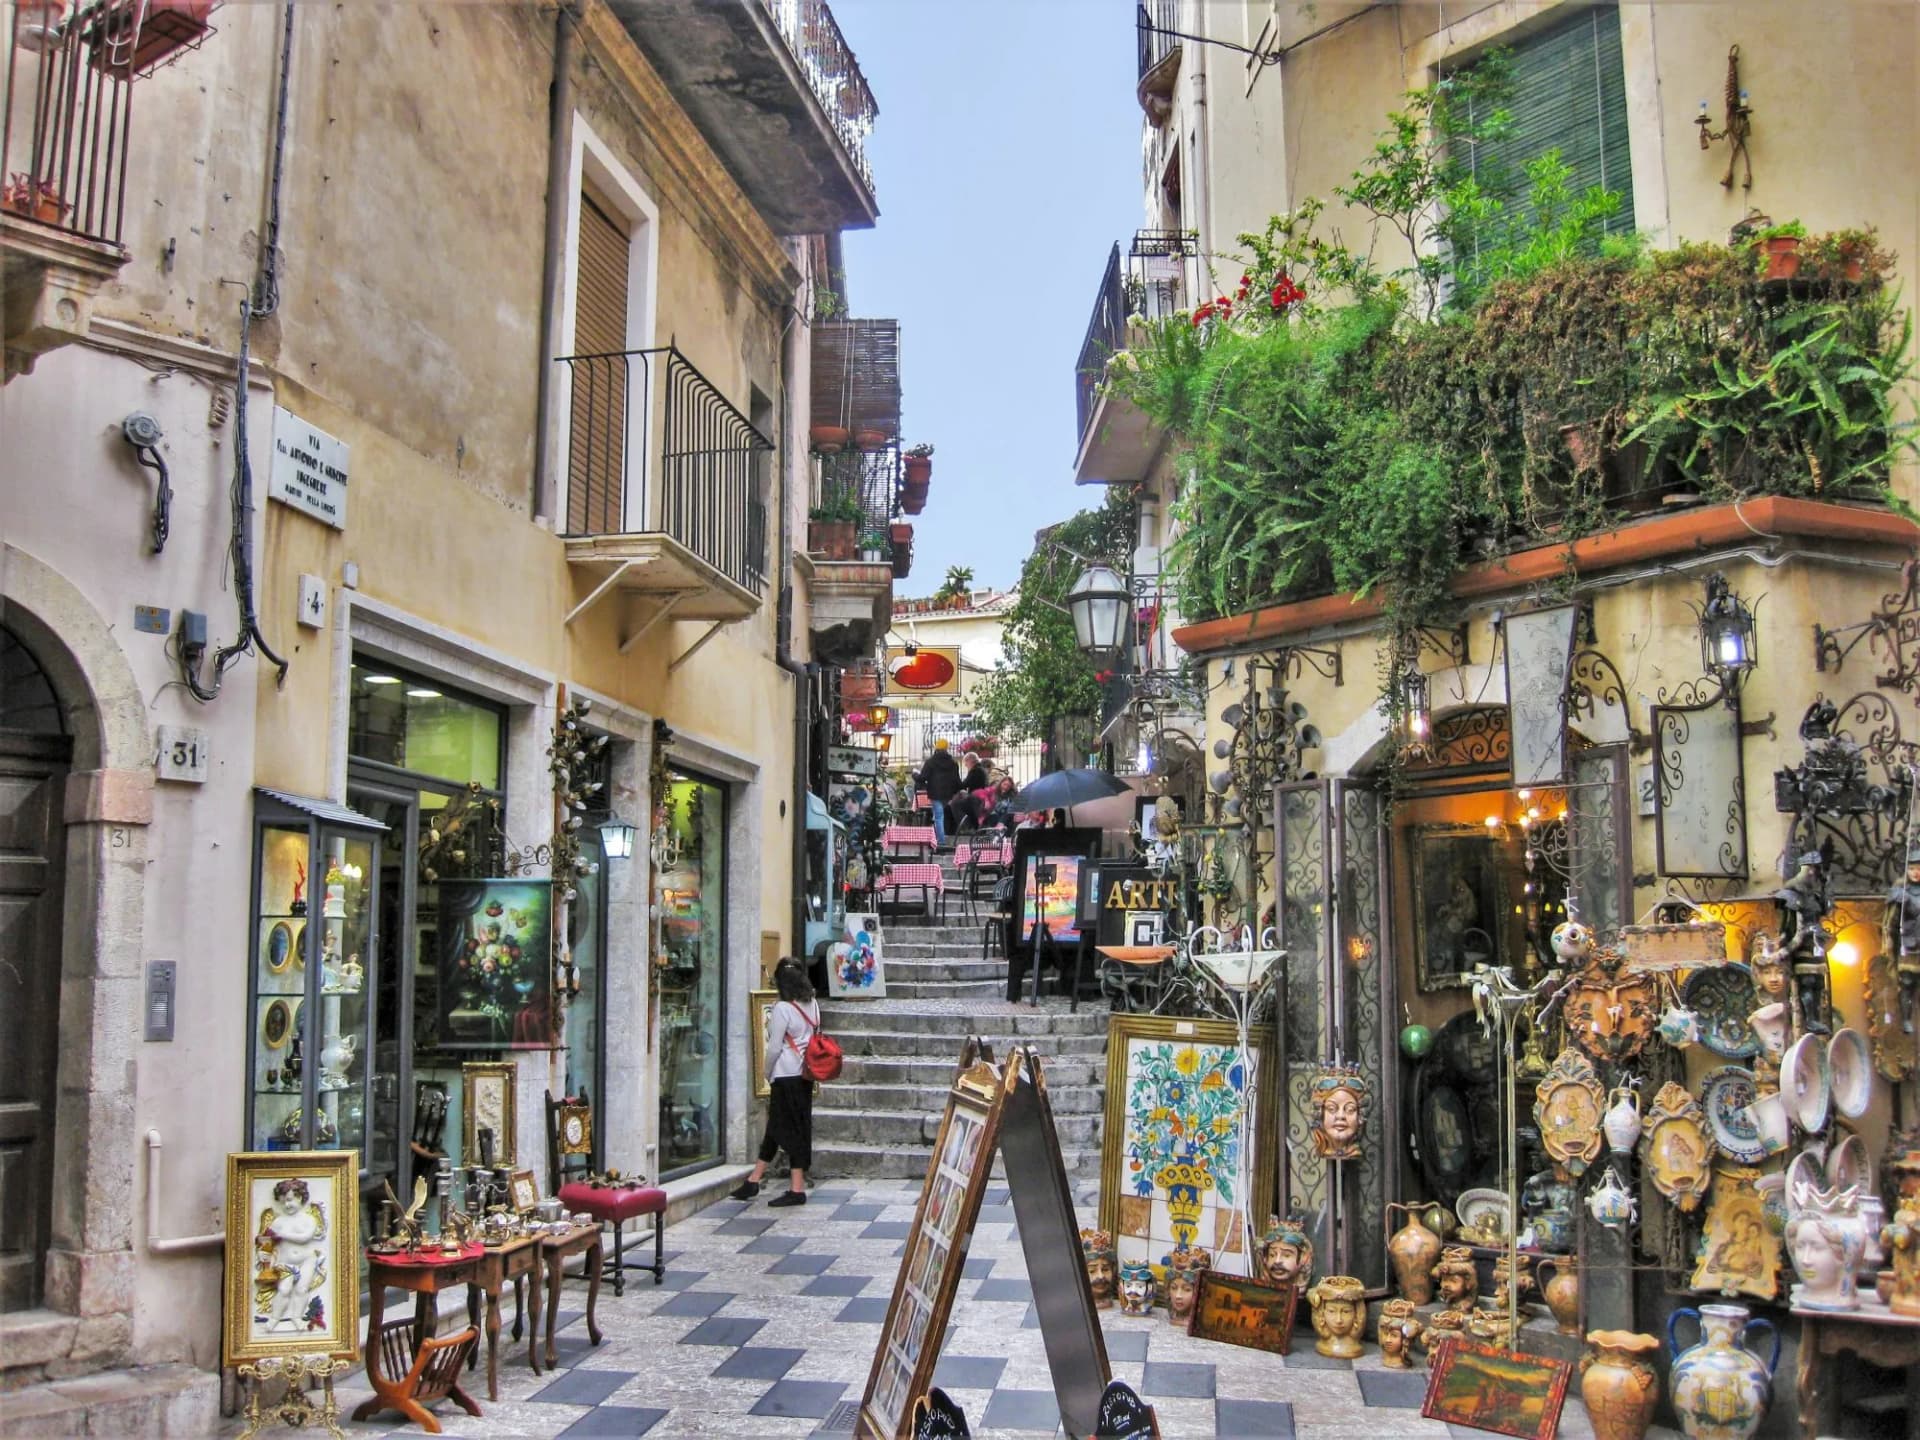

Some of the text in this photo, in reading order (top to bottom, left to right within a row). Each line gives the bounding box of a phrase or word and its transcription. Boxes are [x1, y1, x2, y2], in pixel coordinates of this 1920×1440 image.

[308, 434, 320, 451] VIA
[310, 591, 320, 615] 4
[172, 741, 197, 768] 31
[1642, 780, 1655, 802] 2
[112, 828, 132, 848] 31
